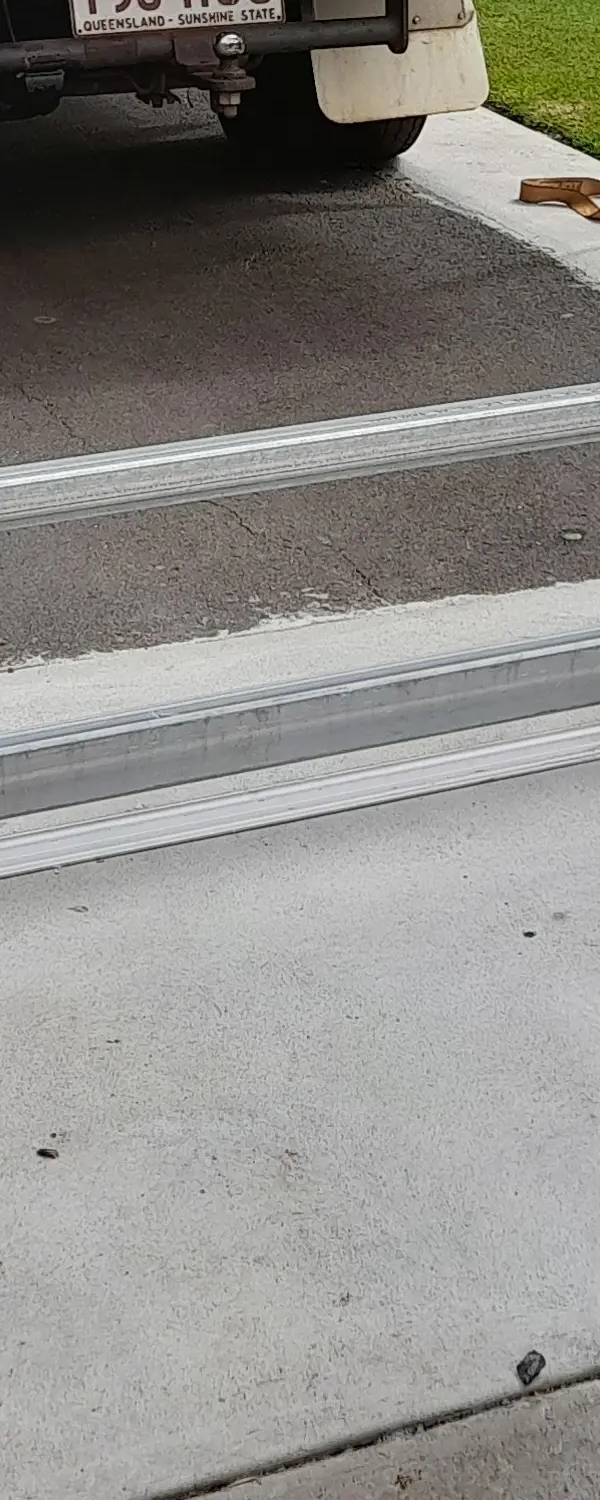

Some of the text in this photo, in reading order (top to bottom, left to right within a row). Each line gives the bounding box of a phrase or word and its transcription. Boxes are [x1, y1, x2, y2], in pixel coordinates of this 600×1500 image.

[83, 16, 165, 32] QUEENSLAND
[178, 11, 234, 26] SUNSHINE
[241, 8, 276, 22] STATE
